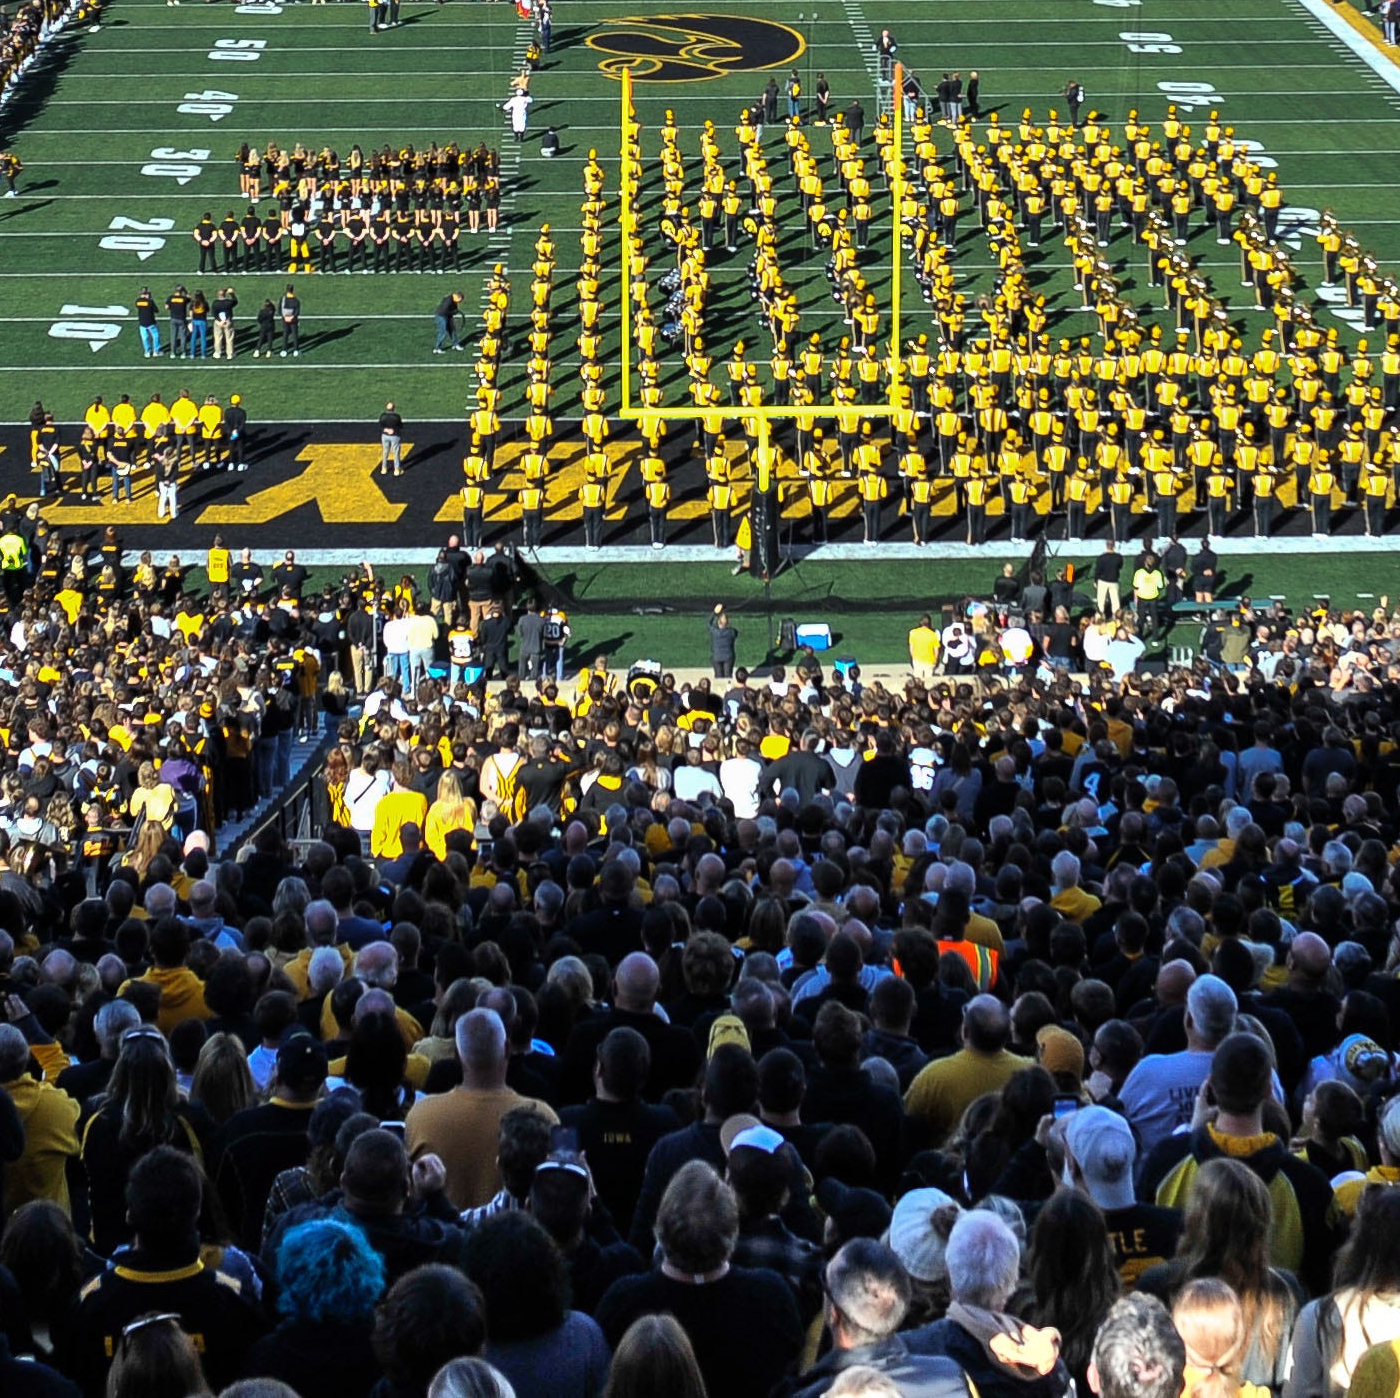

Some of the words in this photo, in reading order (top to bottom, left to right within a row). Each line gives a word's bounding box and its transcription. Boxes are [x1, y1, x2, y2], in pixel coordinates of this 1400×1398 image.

[208, 39, 267, 60] 50
[1119, 32, 1183, 53] 50
[177, 90, 239, 113] 40
[1157, 82, 1225, 105] 40
[140, 147, 211, 176] 30
[98, 216, 175, 250] 20
[48, 304, 130, 339] 10
[603, 1131, 632, 1144] IOWA
[1107, 1228, 1146, 1255] TLE
